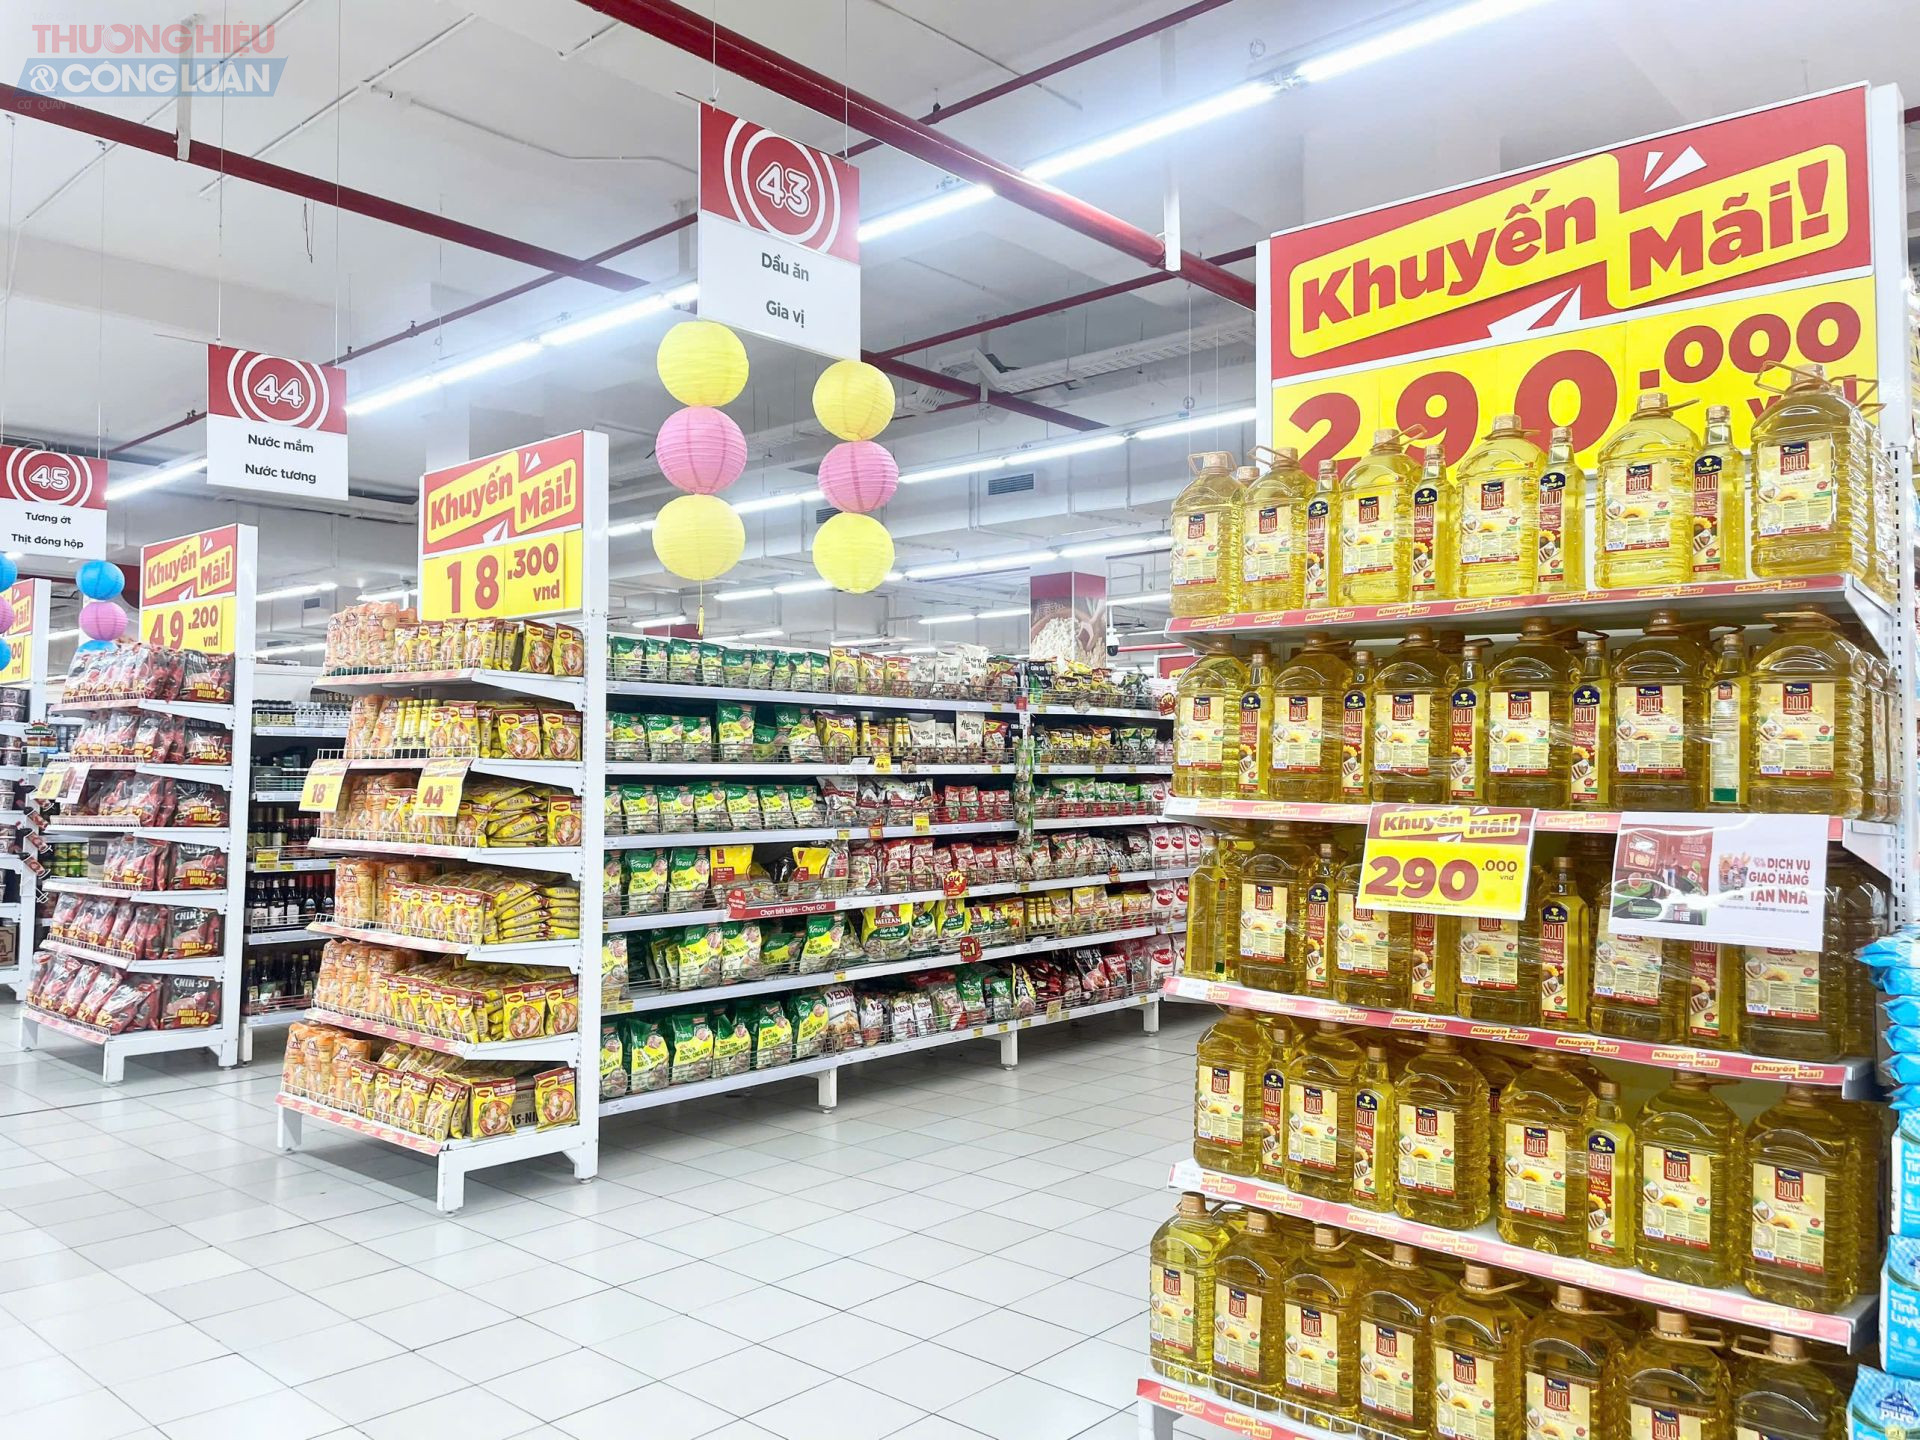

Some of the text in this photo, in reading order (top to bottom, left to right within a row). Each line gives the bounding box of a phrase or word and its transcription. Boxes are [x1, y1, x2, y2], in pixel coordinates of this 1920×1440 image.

[757, 161, 813, 218] 43
[1302, 159, 1831, 334] Khuyến Mãi!
[761, 251, 809, 282] Dầu ăn
[766, 300, 805, 328] Gia vị
[255, 373, 305, 407] 44
[1289, 302, 1861, 476] 290 .000
[248, 433, 314, 454] Nước mắm
[1783, 455, 1806, 471] GOLD
[29, 465, 70, 490] 45
[245, 463, 317, 485] Nước tương
[1629, 475, 1649, 491] GOLD
[1695, 475, 1717, 492] GOLD
[431, 466, 513, 531] Khuyến
[1483, 491, 1502, 507] GOLD
[25, 511, 72, 526] Tương ớt
[1361, 507, 1377, 521] GOLD
[1415, 506, 1433, 519] GOLD
[11, 533, 84, 550] Thịt đóng hộp
[148, 545, 197, 590] Khuyến
[447, 543, 559, 613] 18 .300
[533, 580, 560, 602] vnd
[188, 605, 218, 630] .200
[203, 634, 218, 647] vnd
[1394, 703, 1412, 718] GOLD
[1511, 703, 1529, 716] GOLD
[1640, 698, 1660, 712] GOLD
[1786, 696, 1809, 713] GOLD
[1241, 711, 1258, 724] GOLD
[1345, 710, 1362, 724] GOLD
[1453, 709, 1472, 723] GOLD
[1574, 707, 1595, 722] GOLD
[1383, 811, 1463, 832] Khuyến
[1767, 857, 1810, 874] DỊCH VỤ
[209, 873, 217, 885] 2
[1365, 856, 1517, 901] 290 .000
[1749, 870, 1809, 886] GIAO HÀNG
[1308, 904, 1326, 919] GOLD
[875, 917, 901, 925] MEIZAN
[1415, 914, 1435, 928] GOLD
[1543, 923, 1564, 940] GOLD
[174, 978, 209, 988] CHIN-SU
[201, 1010, 209, 1025] 2
[1213, 1077, 1228, 1093] GOLD
[1264, 1089, 1280, 1104] GOLD
[1305, 1096, 1322, 1112] GOLD
[1356, 1110, 1374, 1127] GOLD
[1417, 1117, 1435, 1135] GOLD
[1526, 1138, 1546, 1155] GOLD
[1590, 1152, 1611, 1171] GOLD
[1667, 1161, 1688, 1178] GOLD
[1777, 1181, 1799, 1200] GOLD
[1164, 1278, 1181, 1294] GOLD
[1230, 1299, 1246, 1317] GOLD
[1891, 1299, 1918, 1315] Tinh
[1302, 1318, 1321, 1337] GOLD
[1377, 1337, 1396, 1357] GOLD
[1455, 1364, 1474, 1384] GOLD
[1547, 1389, 1569, 1409] GOLD
[1881, 1409, 1914, 1424] pure
[1655, 1422, 1677, 1440] GOLD
